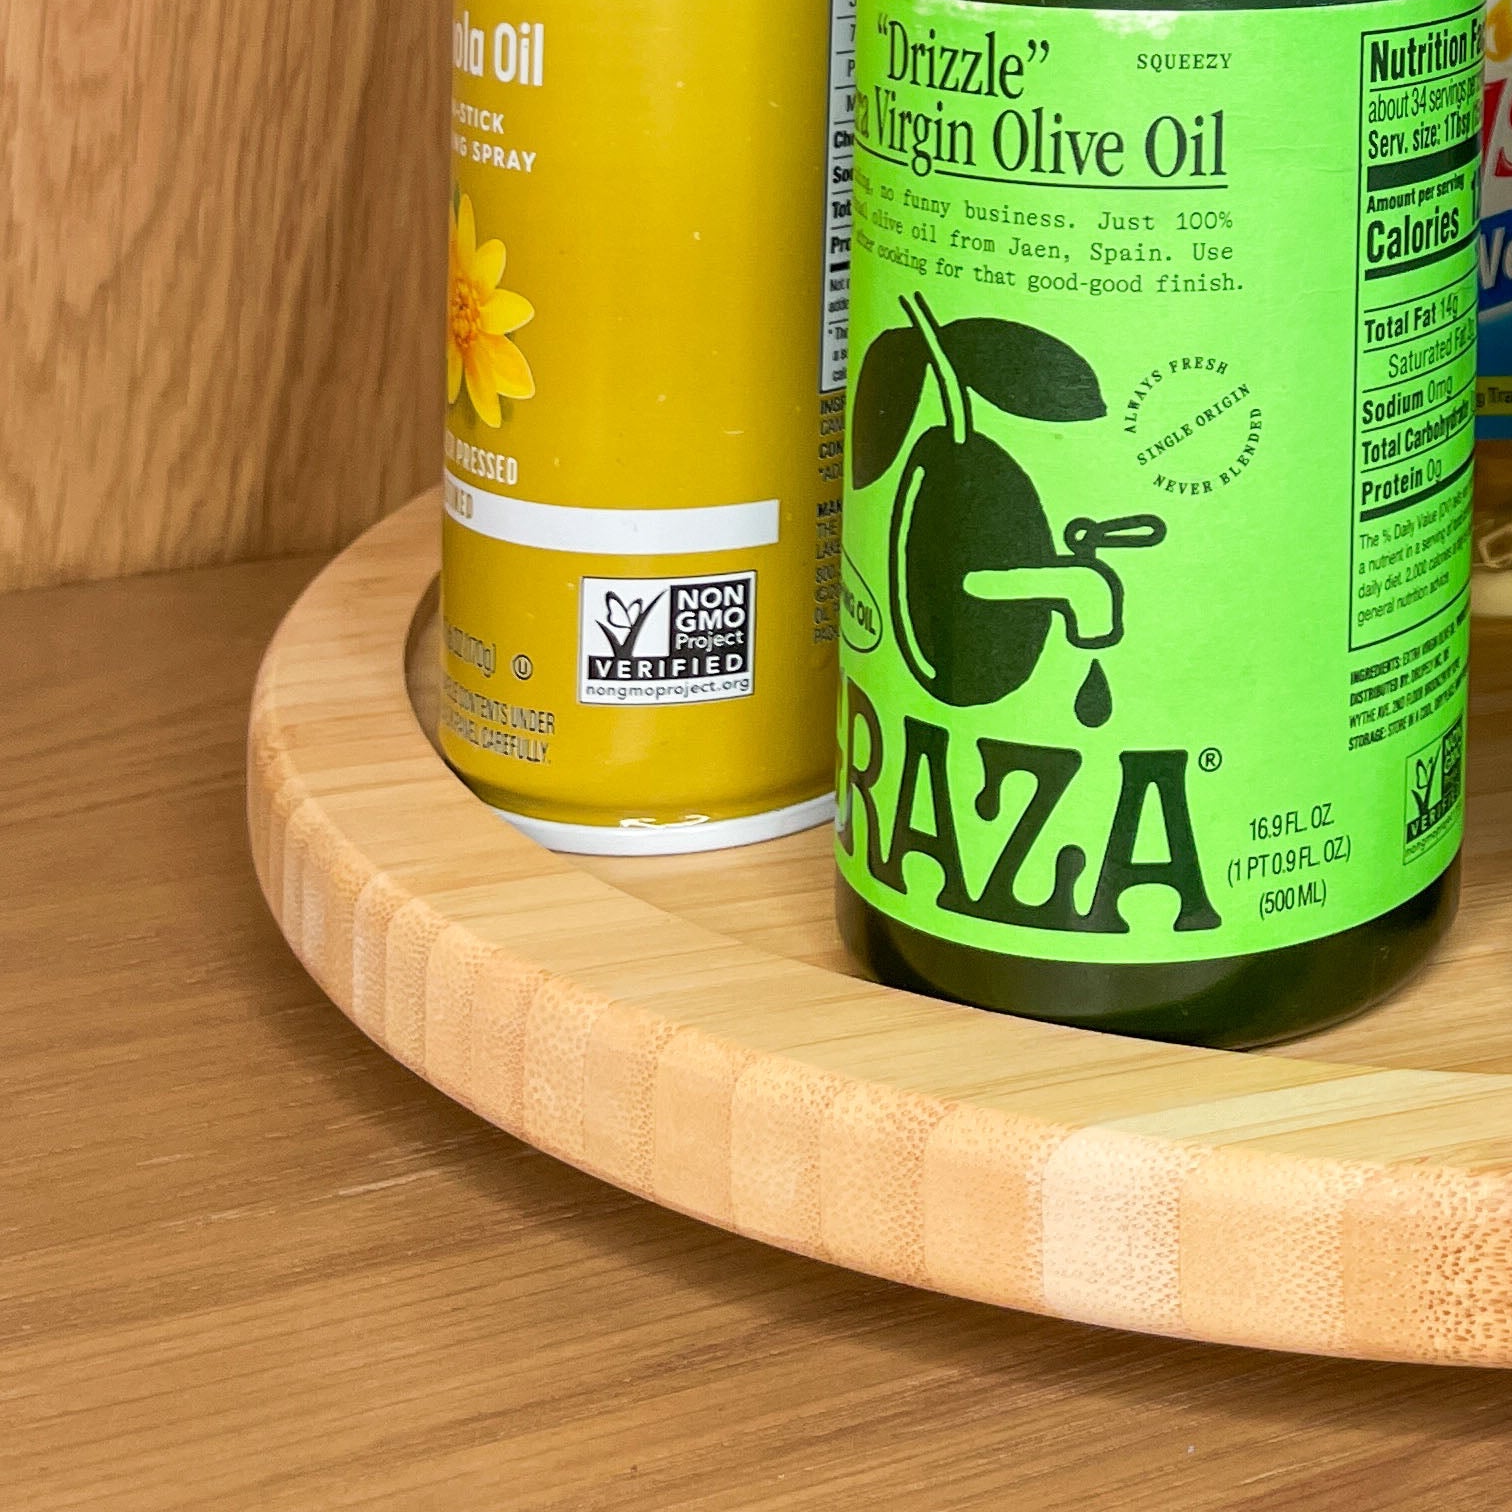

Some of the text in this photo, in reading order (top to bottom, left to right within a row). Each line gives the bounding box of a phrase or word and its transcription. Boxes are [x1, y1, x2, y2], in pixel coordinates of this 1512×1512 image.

[493, 22, 545, 87] Oil
[878, 13, 1233, 100] “Drizzle” SQUEEZY
[1369, 31, 1468, 84] Nutrition
[1368, 92, 1410, 124] about
[1411, 87, 1427, 114] 34
[873, 85, 977, 177] Virgin
[992, 109, 1125, 178] Olive
[1144, 109, 1229, 179] Oil
[1368, 122, 1441, 161] Serv. size:
[472, 140, 537, 175] SPRAY
[903, 188, 1233, 230] funny business. Just 100%
[1366, 187, 1416, 215] Amount
[1416, 184, 1436, 209] per
[872, 209, 1234, 267] olive oil from Jaen, Spain. Use
[1366, 205, 1460, 264] Calories
[877, 243, 1244, 296] cooking for that good-good finish.
[1364, 304, 1437, 345] Total Fat
[1124, 356, 1228, 434] ALWAYS FRESH
[1362, 391, 1424, 425] Sodium
[1136, 383, 1251, 466] SINGLE ORIGIN
[455, 444, 519, 486] PRESSED
[1153, 407, 1263, 496] NEVER BLENDED
[1361, 431, 1401, 466] Total
[1361, 469, 1424, 507] Protein
[676, 584, 746, 609] NON
[675, 607, 747, 633] GMO
[856, 603, 877, 635] OIL
[675, 629, 746, 652] Project
[595, 652, 745, 679] VERIFIED
[585, 676, 752, 700] nongmoproject.org
[1249, 802, 1335, 841] 16.9 FL OZ
[1227, 834, 1352, 889] (1 PT 0.9 FL OZ)
[1259, 878, 1327, 921] (500 ML)
